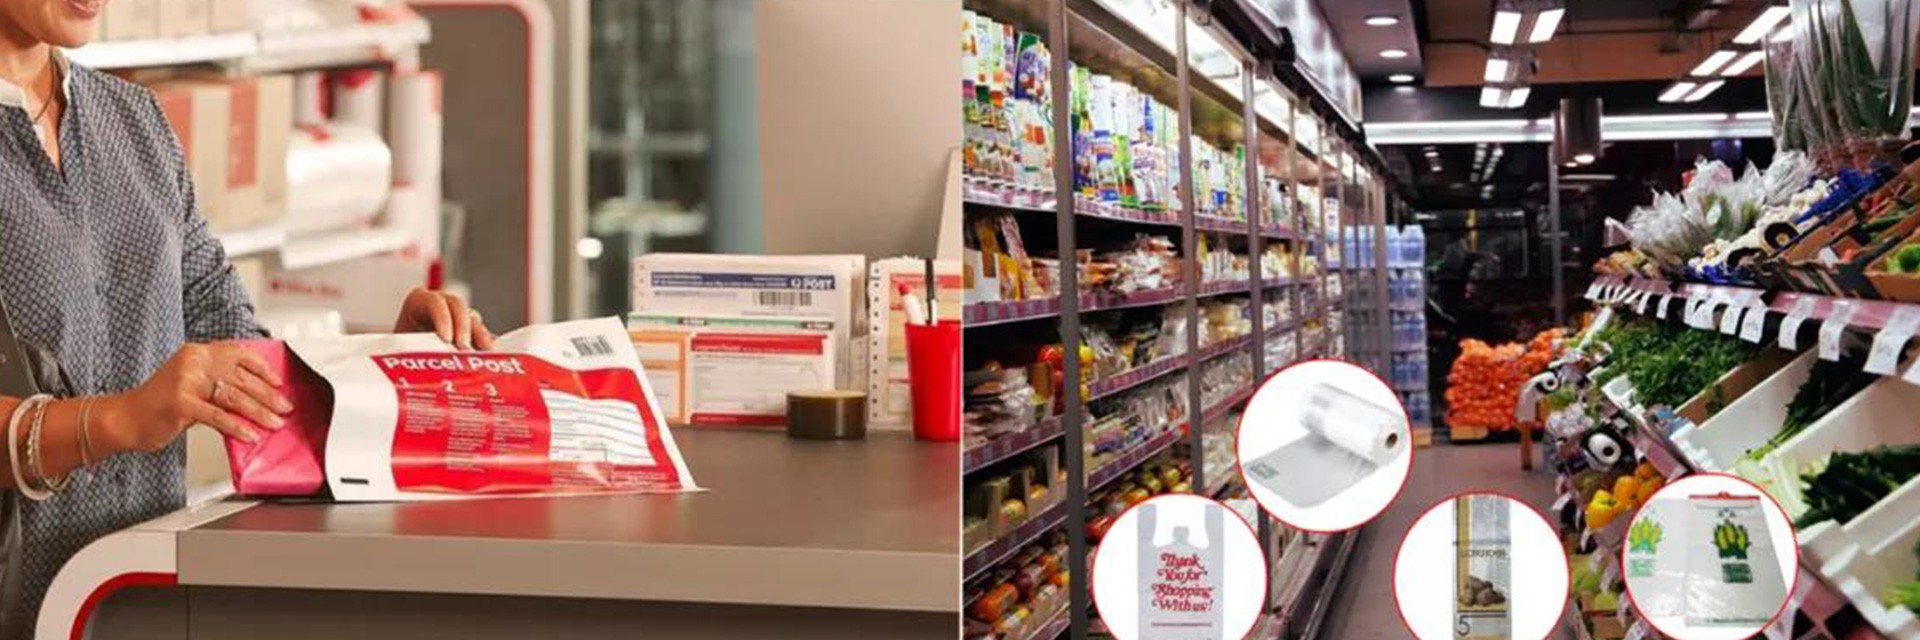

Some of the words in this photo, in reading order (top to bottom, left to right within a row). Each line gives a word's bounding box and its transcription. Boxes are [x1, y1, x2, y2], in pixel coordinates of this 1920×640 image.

[383, 356, 464, 370] Parcel
[467, 357, 526, 374] Post
[398, 377, 411, 388] 1
[442, 379, 456, 392] 2
[484, 383, 498, 396] 3
[1161, 553, 1204, 570] Thank
[1157, 569, 1185, 581] You
[1181, 568, 1208, 584] for
[1151, 583, 1214, 600] Shopping
[1151, 599, 1191, 611] With
[1457, 615, 1472, 636] 5
